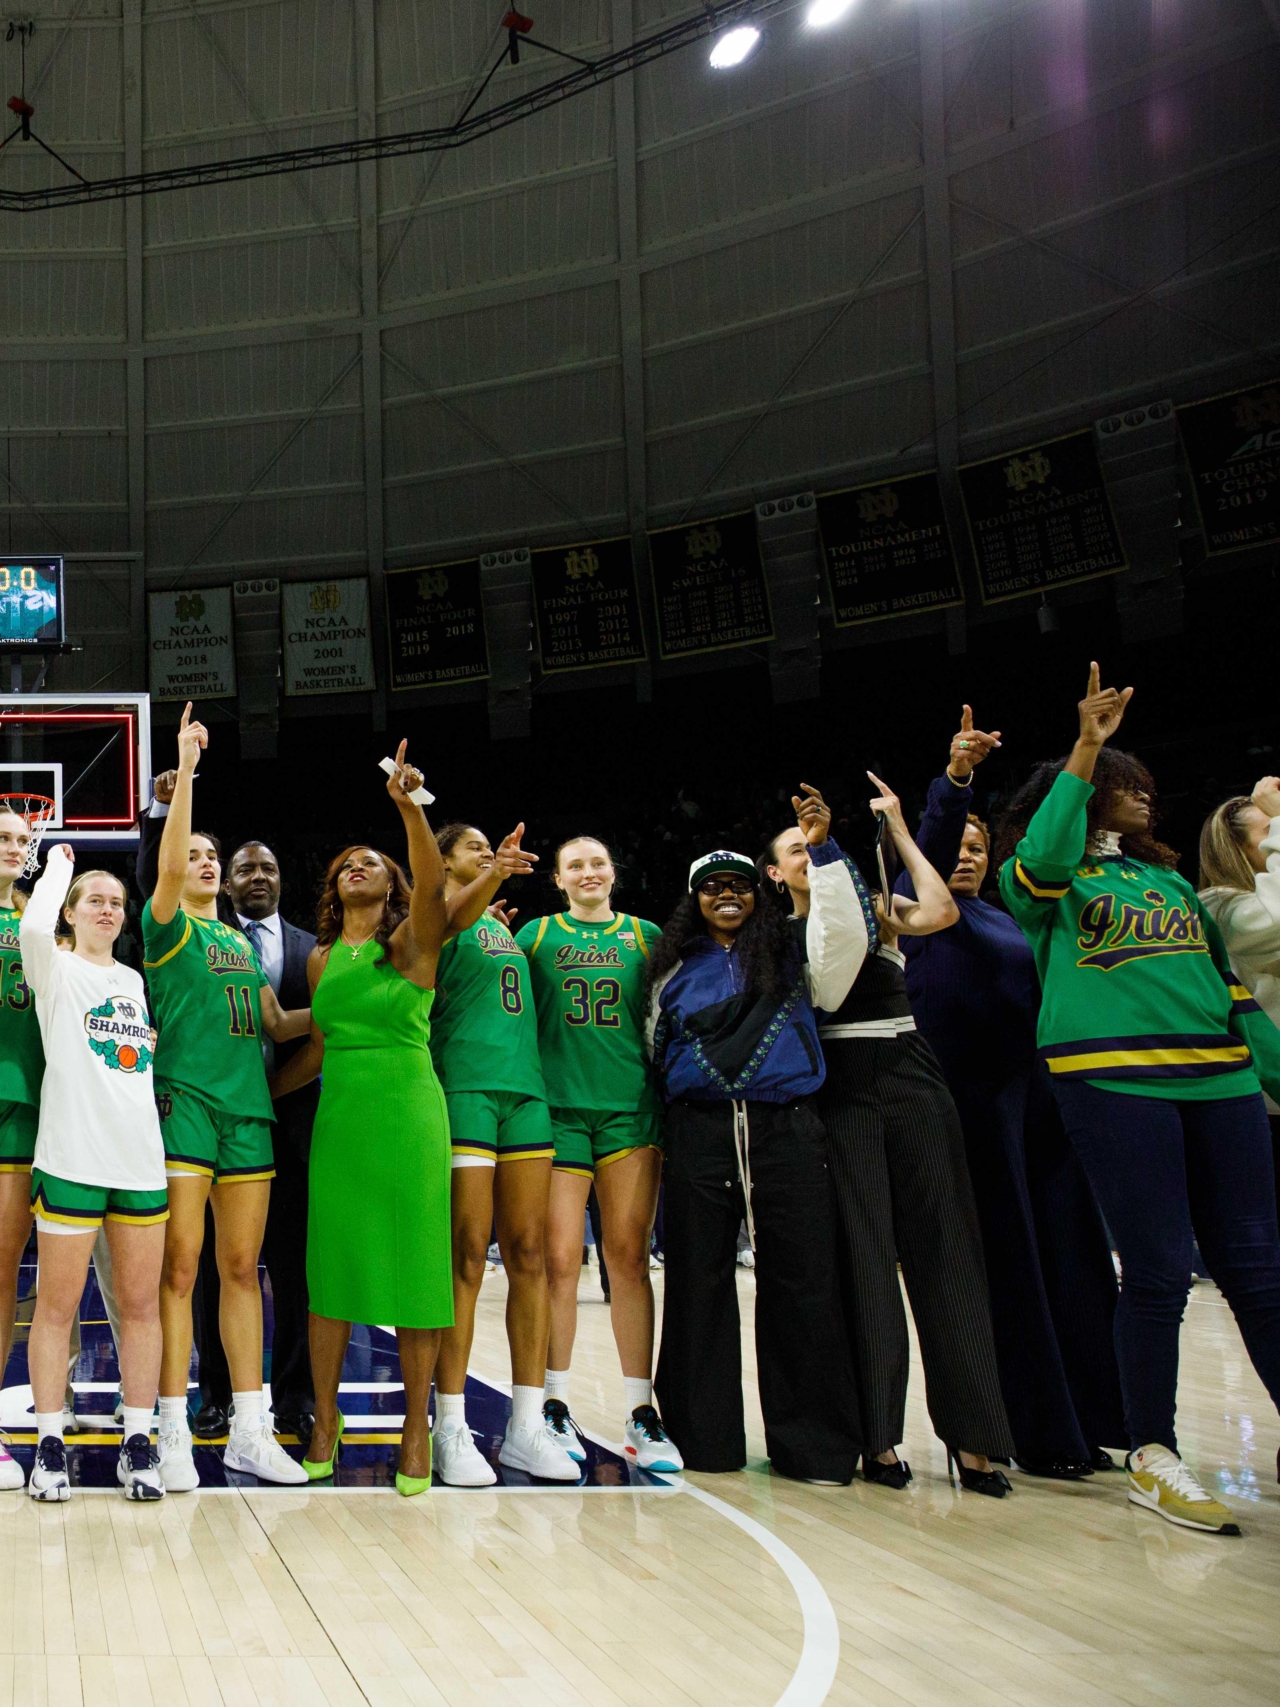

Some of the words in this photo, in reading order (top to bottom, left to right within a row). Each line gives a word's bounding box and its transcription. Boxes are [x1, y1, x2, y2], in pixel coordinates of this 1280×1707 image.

[1008, 485, 1063, 510] NCAA
[1216, 488, 1269, 511] 2019
[975, 487, 1101, 531] TOURNAMENT
[860, 520, 909, 538] NCAA
[1211, 522, 1277, 546] WOMEN'S
[828, 524, 943, 557] TOURNAMENT
[685, 557, 729, 575] NCAA
[986, 573, 1041, 595] WOMEN'S
[1045, 552, 1120, 581] BASKETBALL
[564, 580, 605, 594] NCAA
[672, 570, 724, 591] SWEET
[731, 565, 746, 578] 16
[416, 601, 454, 614] NCAA
[543, 594, 586, 609] FINAL
[590, 588, 629, 602] FOUR
[838, 601, 888, 619] WOMEN'S
[891, 586, 957, 609] BASKETBALL
[305, 616, 349, 629] NCAA
[395, 615, 436, 628] FINAL
[440, 607, 477, 622] FOUR
[548, 611, 578, 625] 1997
[597, 603, 628, 618] 2001
[170, 624, 212, 637] NCAA
[288, 628, 366, 643] CHAMPION
[401, 630, 429, 644] 2015
[445, 623, 475, 637] 2018
[551, 624, 580, 638] 2011
[598, 618, 629, 632] 2012
[663, 635, 708, 651] WOMEN'S
[710, 623, 769, 643] BASKETBALL
[153, 635, 228, 650] CHAMPION
[402, 643, 430, 657] 2019
[552, 638, 582, 652] 2013
[600, 631, 631, 646] 2014
[177, 654, 207, 666] 2018
[314, 647, 343, 659] 2001
[545, 651, 586, 666] WOMEN'S
[588, 645, 641, 661] BASKETBALL
[167, 672, 219, 684] WOMEN'S
[303, 665, 357, 677] WOMEN'S
[395, 670, 433, 684] WOMEN'S
[435, 663, 486, 679] BASKETBALL
[159, 683, 227, 697] BASKETBALL
[295, 677, 365, 690] BASKETBALL
[207, 944, 252, 968] Irish
[554, 944, 620, 965] Irish
[500, 964, 523, 1015] 8
[224, 984, 257, 1037] 11
[562, 977, 621, 1028] 32
